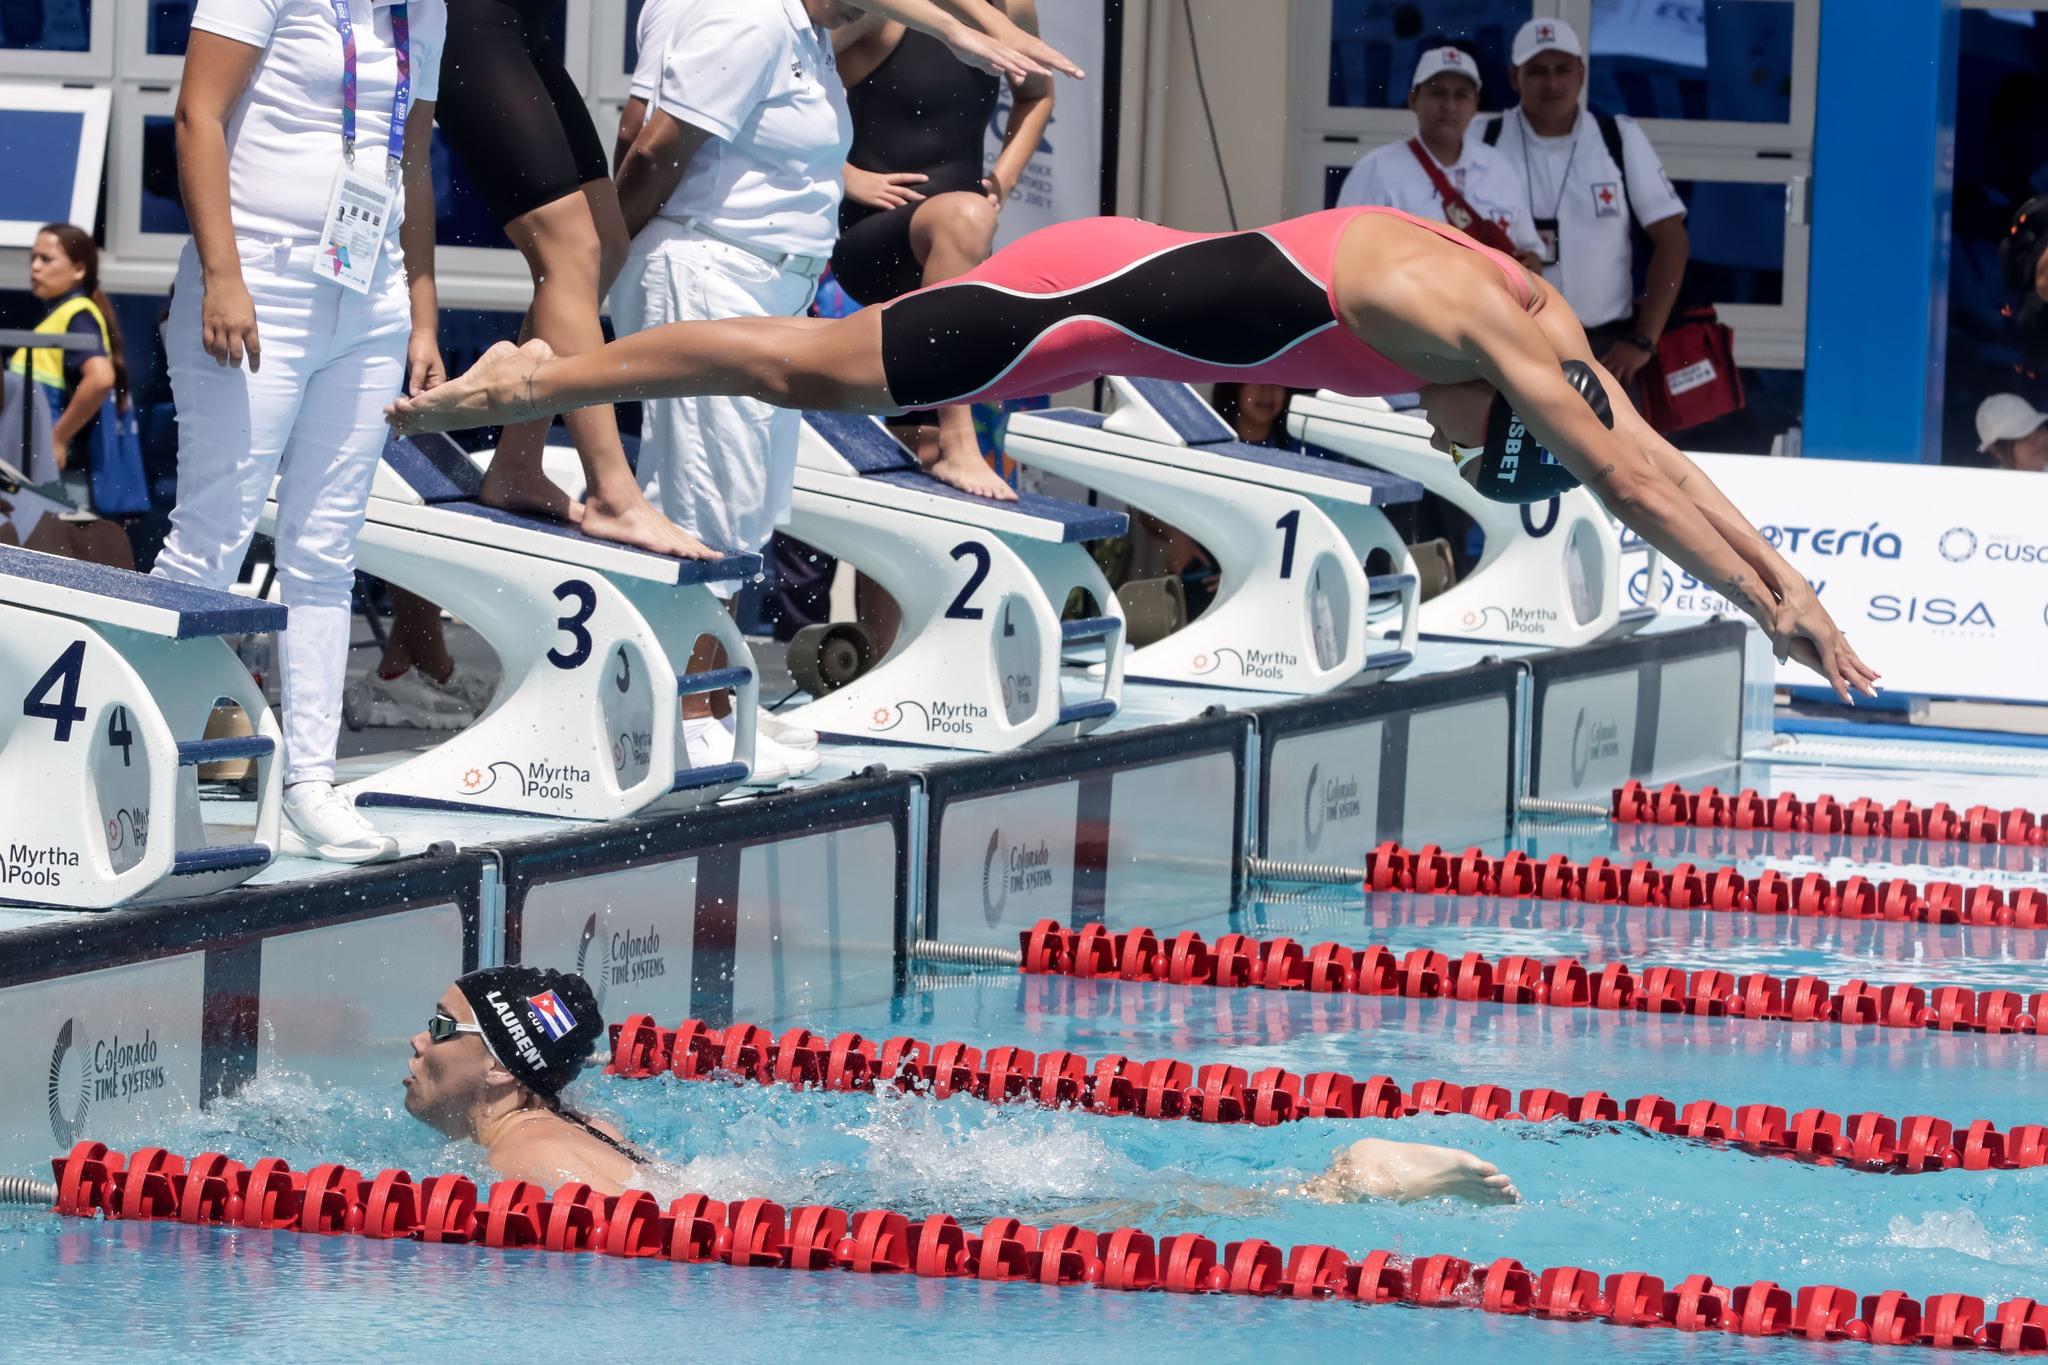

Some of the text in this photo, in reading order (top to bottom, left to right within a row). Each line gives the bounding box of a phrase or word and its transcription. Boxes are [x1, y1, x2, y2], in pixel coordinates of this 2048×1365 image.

[1276, 510, 1300, 579] 1
[944, 541, 991, 620] 2
[1511, 607, 1557, 621] Myrtha
[1677, 595, 1741, 612] El Salv
[1867, 594, 1996, 628] SISA
[547, 580, 597, 670] 3
[1510, 620, 1545, 633] Pools
[1247, 649, 1297, 666] Myrtha
[1246, 664, 1284, 679] Pools
[24, 640, 87, 742] 4
[932, 701, 988, 719] Myrtha
[108, 705, 132, 767] 4
[931, 718, 973, 734] Pools
[529, 762, 590, 783] Myrtha
[528, 781, 574, 799] Pools
[9, 844, 79, 867] Myrtha
[8, 865, 61, 886] Pools
[612, 957, 665, 988] TIME SYSTEMS
[486, 991, 548, 1072] LAURENT
[527, 1011, 545, 1034] CUB
[95, 1066, 164, 1103] TIME SYSTEMS
